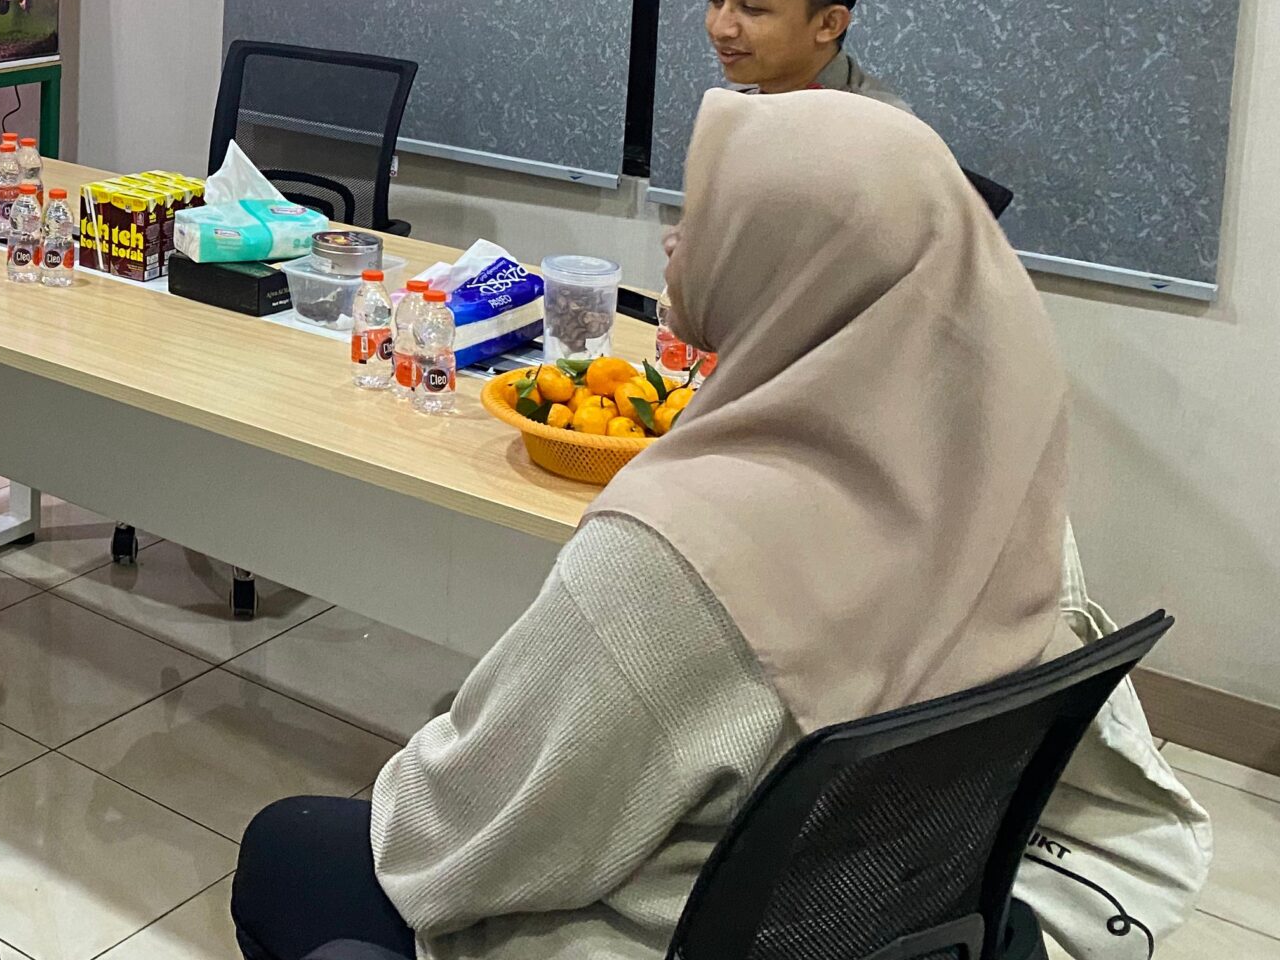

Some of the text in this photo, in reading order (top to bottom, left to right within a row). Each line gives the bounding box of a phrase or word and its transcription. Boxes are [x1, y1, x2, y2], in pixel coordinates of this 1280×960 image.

[111, 223, 144, 250] teh
[16, 251, 31, 262] Cleo
[46, 253, 61, 263] Cleo
[111, 244, 144, 263] kotak
[429, 374, 447, 386] Cleo
